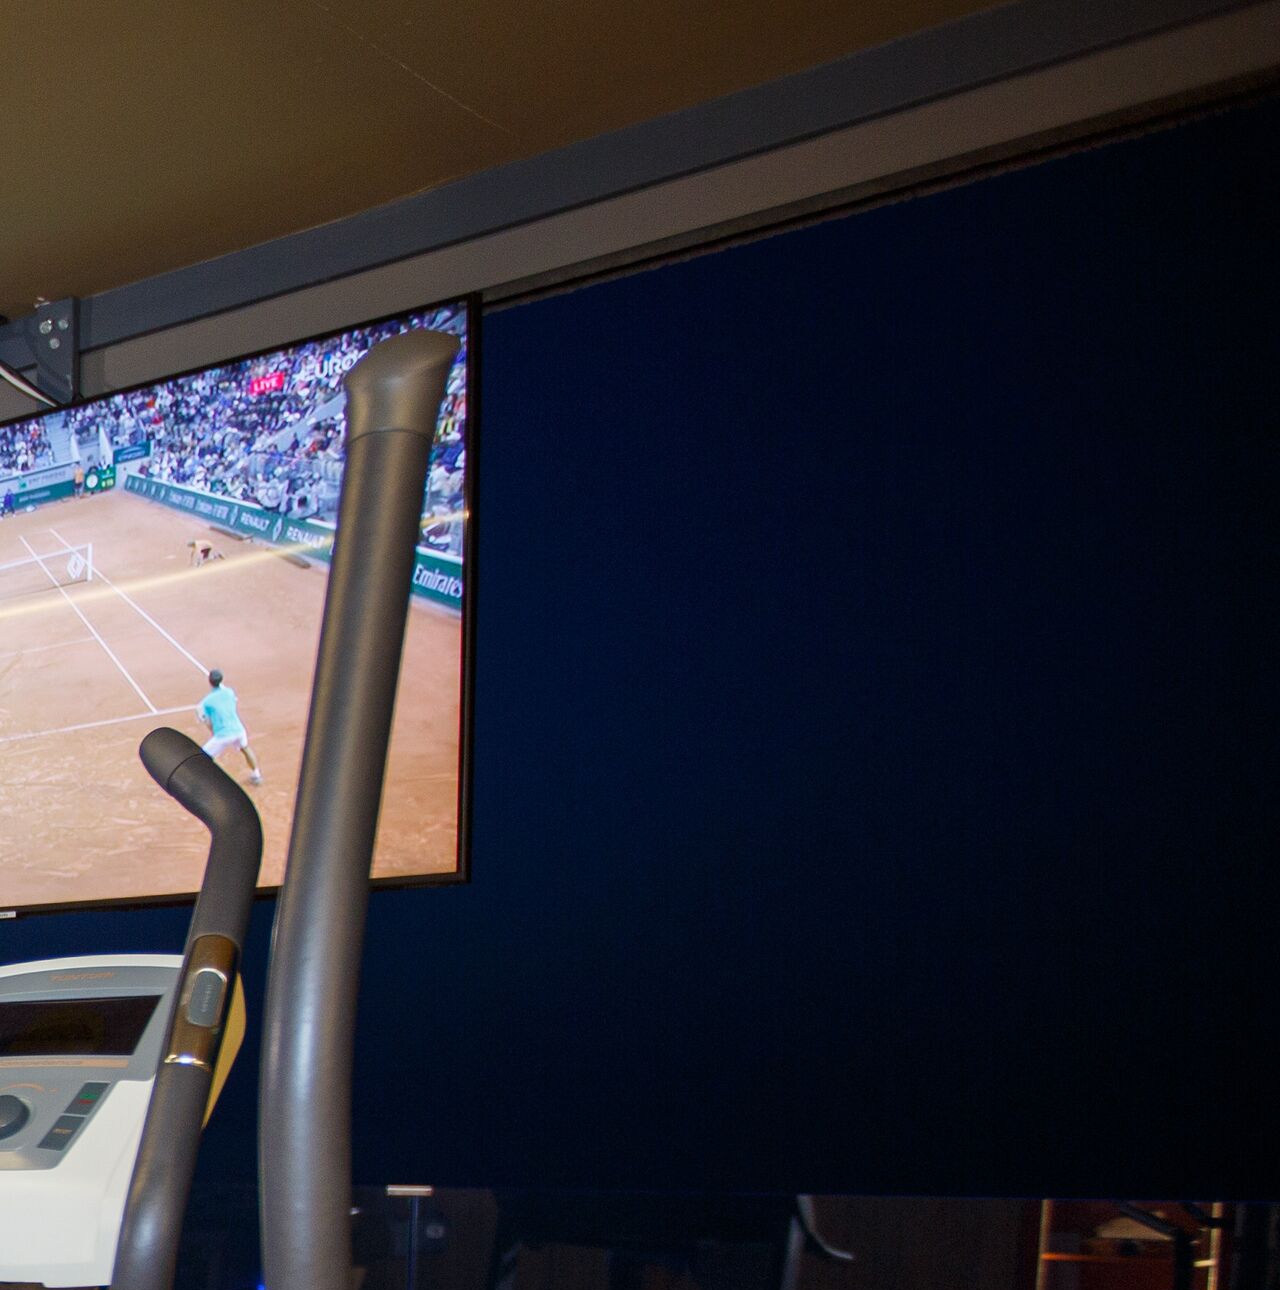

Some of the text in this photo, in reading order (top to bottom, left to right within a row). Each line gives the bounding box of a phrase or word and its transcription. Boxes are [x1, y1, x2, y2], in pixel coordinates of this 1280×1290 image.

[253, 373, 279, 391] LIVE
[240, 512, 270, 531] RENAULT
[287, 526, 325, 548] RENAULT
